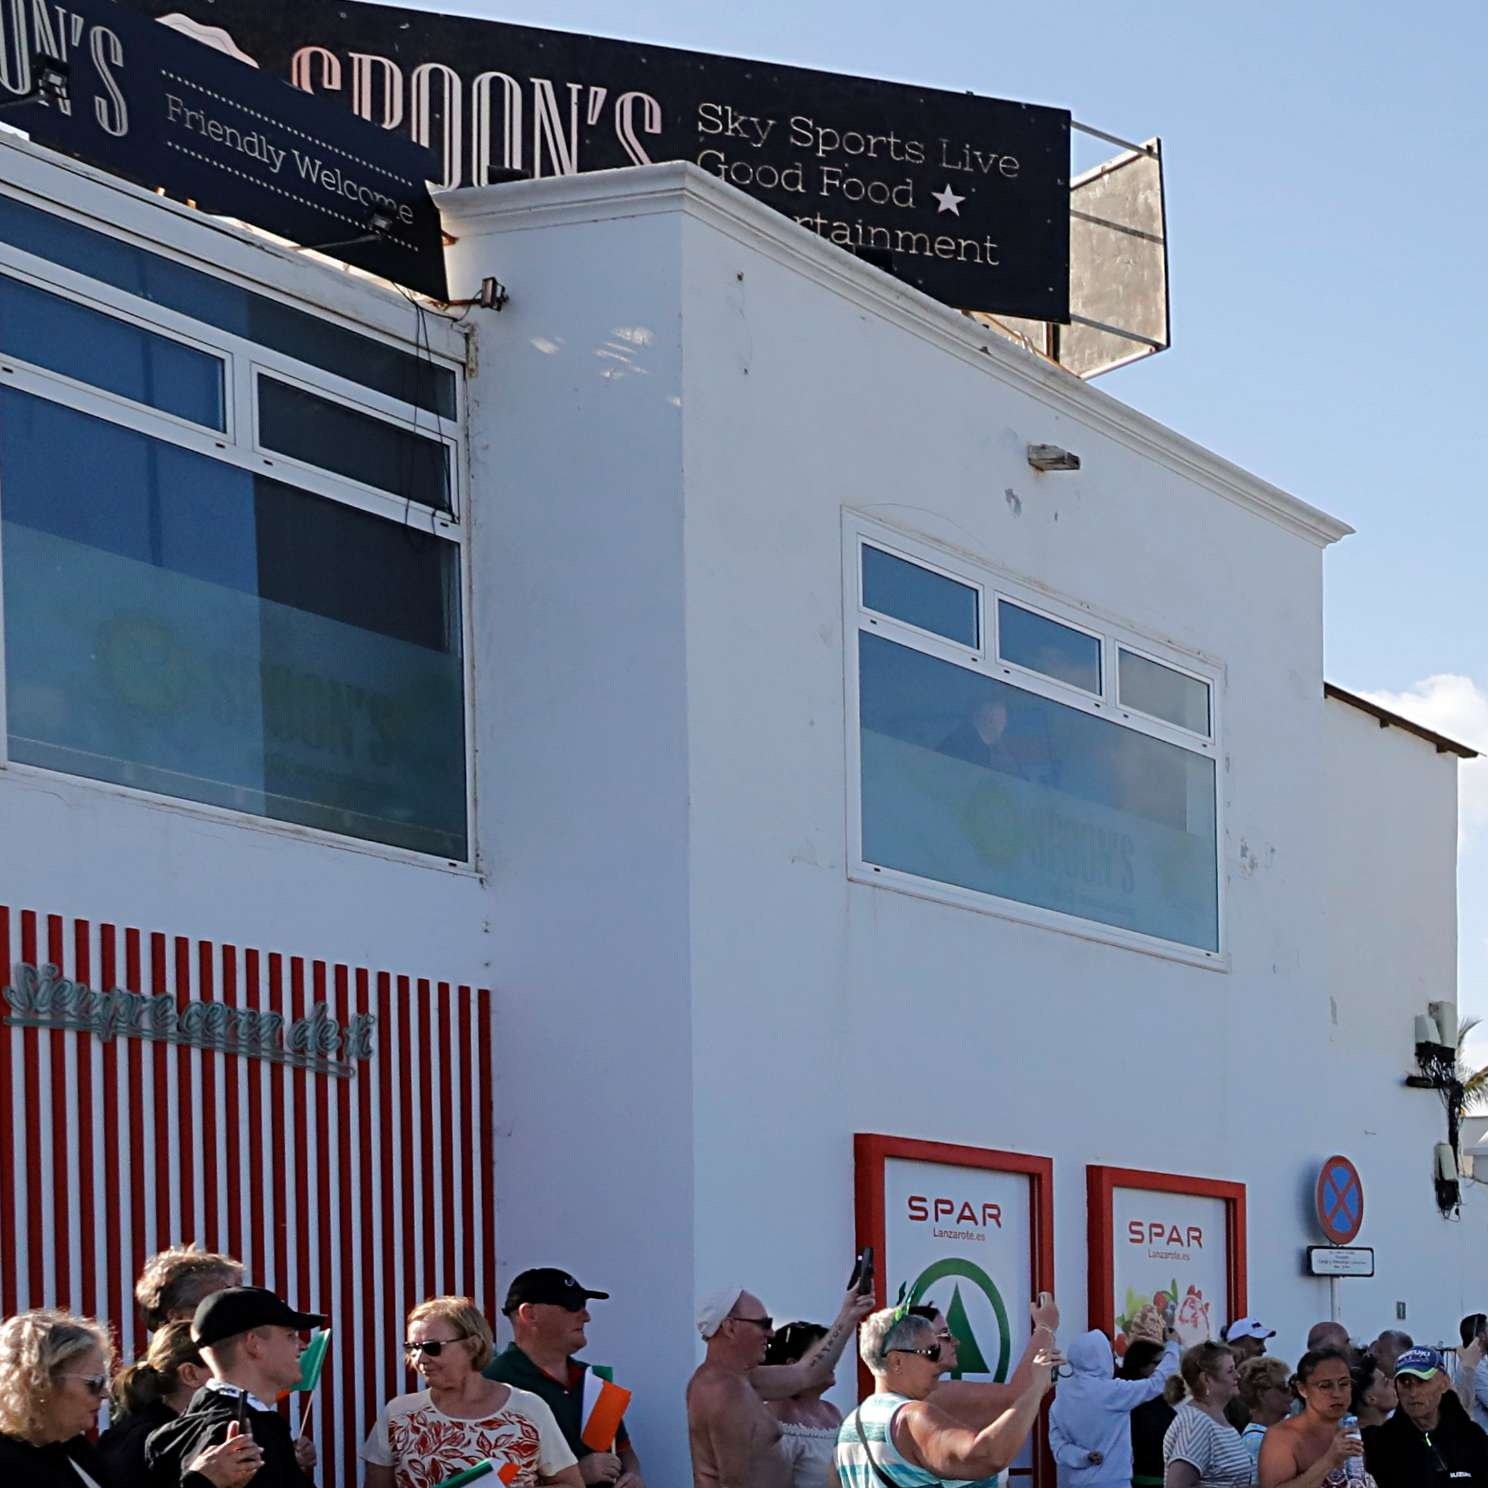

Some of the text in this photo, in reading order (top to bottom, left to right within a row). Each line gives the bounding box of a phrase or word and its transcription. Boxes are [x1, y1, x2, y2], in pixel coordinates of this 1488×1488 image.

[165, 93, 287, 174] Friendly
[697, 103, 1021, 179] Sky Sports Live
[697, 149, 918, 210] Good Food
[286, 1002, 342, 1053] de
[343, 1012, 376, 1059] ti
[907, 1194, 1002, 1229] SPAR
[933, 1227, 986, 1242] Lanzarote.es
[1128, 1220, 1203, 1249] SPAR
